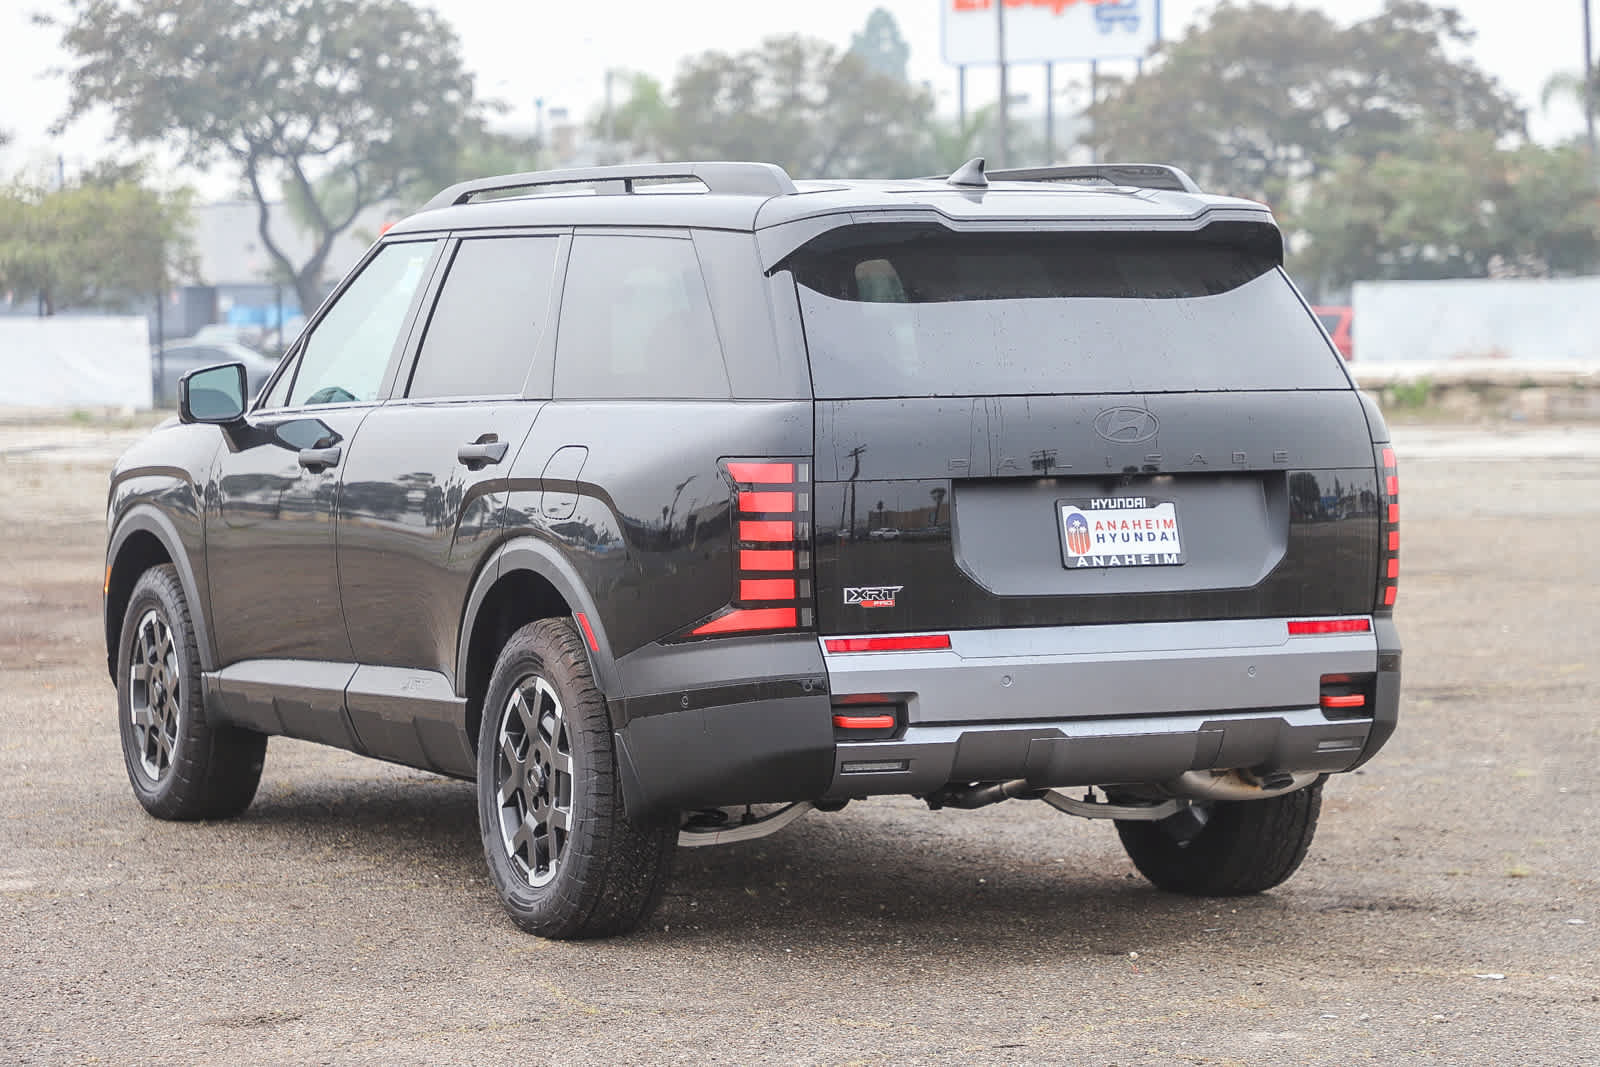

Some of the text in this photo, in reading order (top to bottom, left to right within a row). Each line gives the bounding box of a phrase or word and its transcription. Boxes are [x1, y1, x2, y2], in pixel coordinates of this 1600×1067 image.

[948, 450, 1292, 472] PALISADE
[1091, 497, 1146, 509] HYUNDAI
[1095, 519, 1175, 531] ANAHEIM
[1096, 531, 1176, 543] HYUNDAI
[1076, 553, 1178, 567] ANAHEIM
[843, 585, 905, 604] XRT
